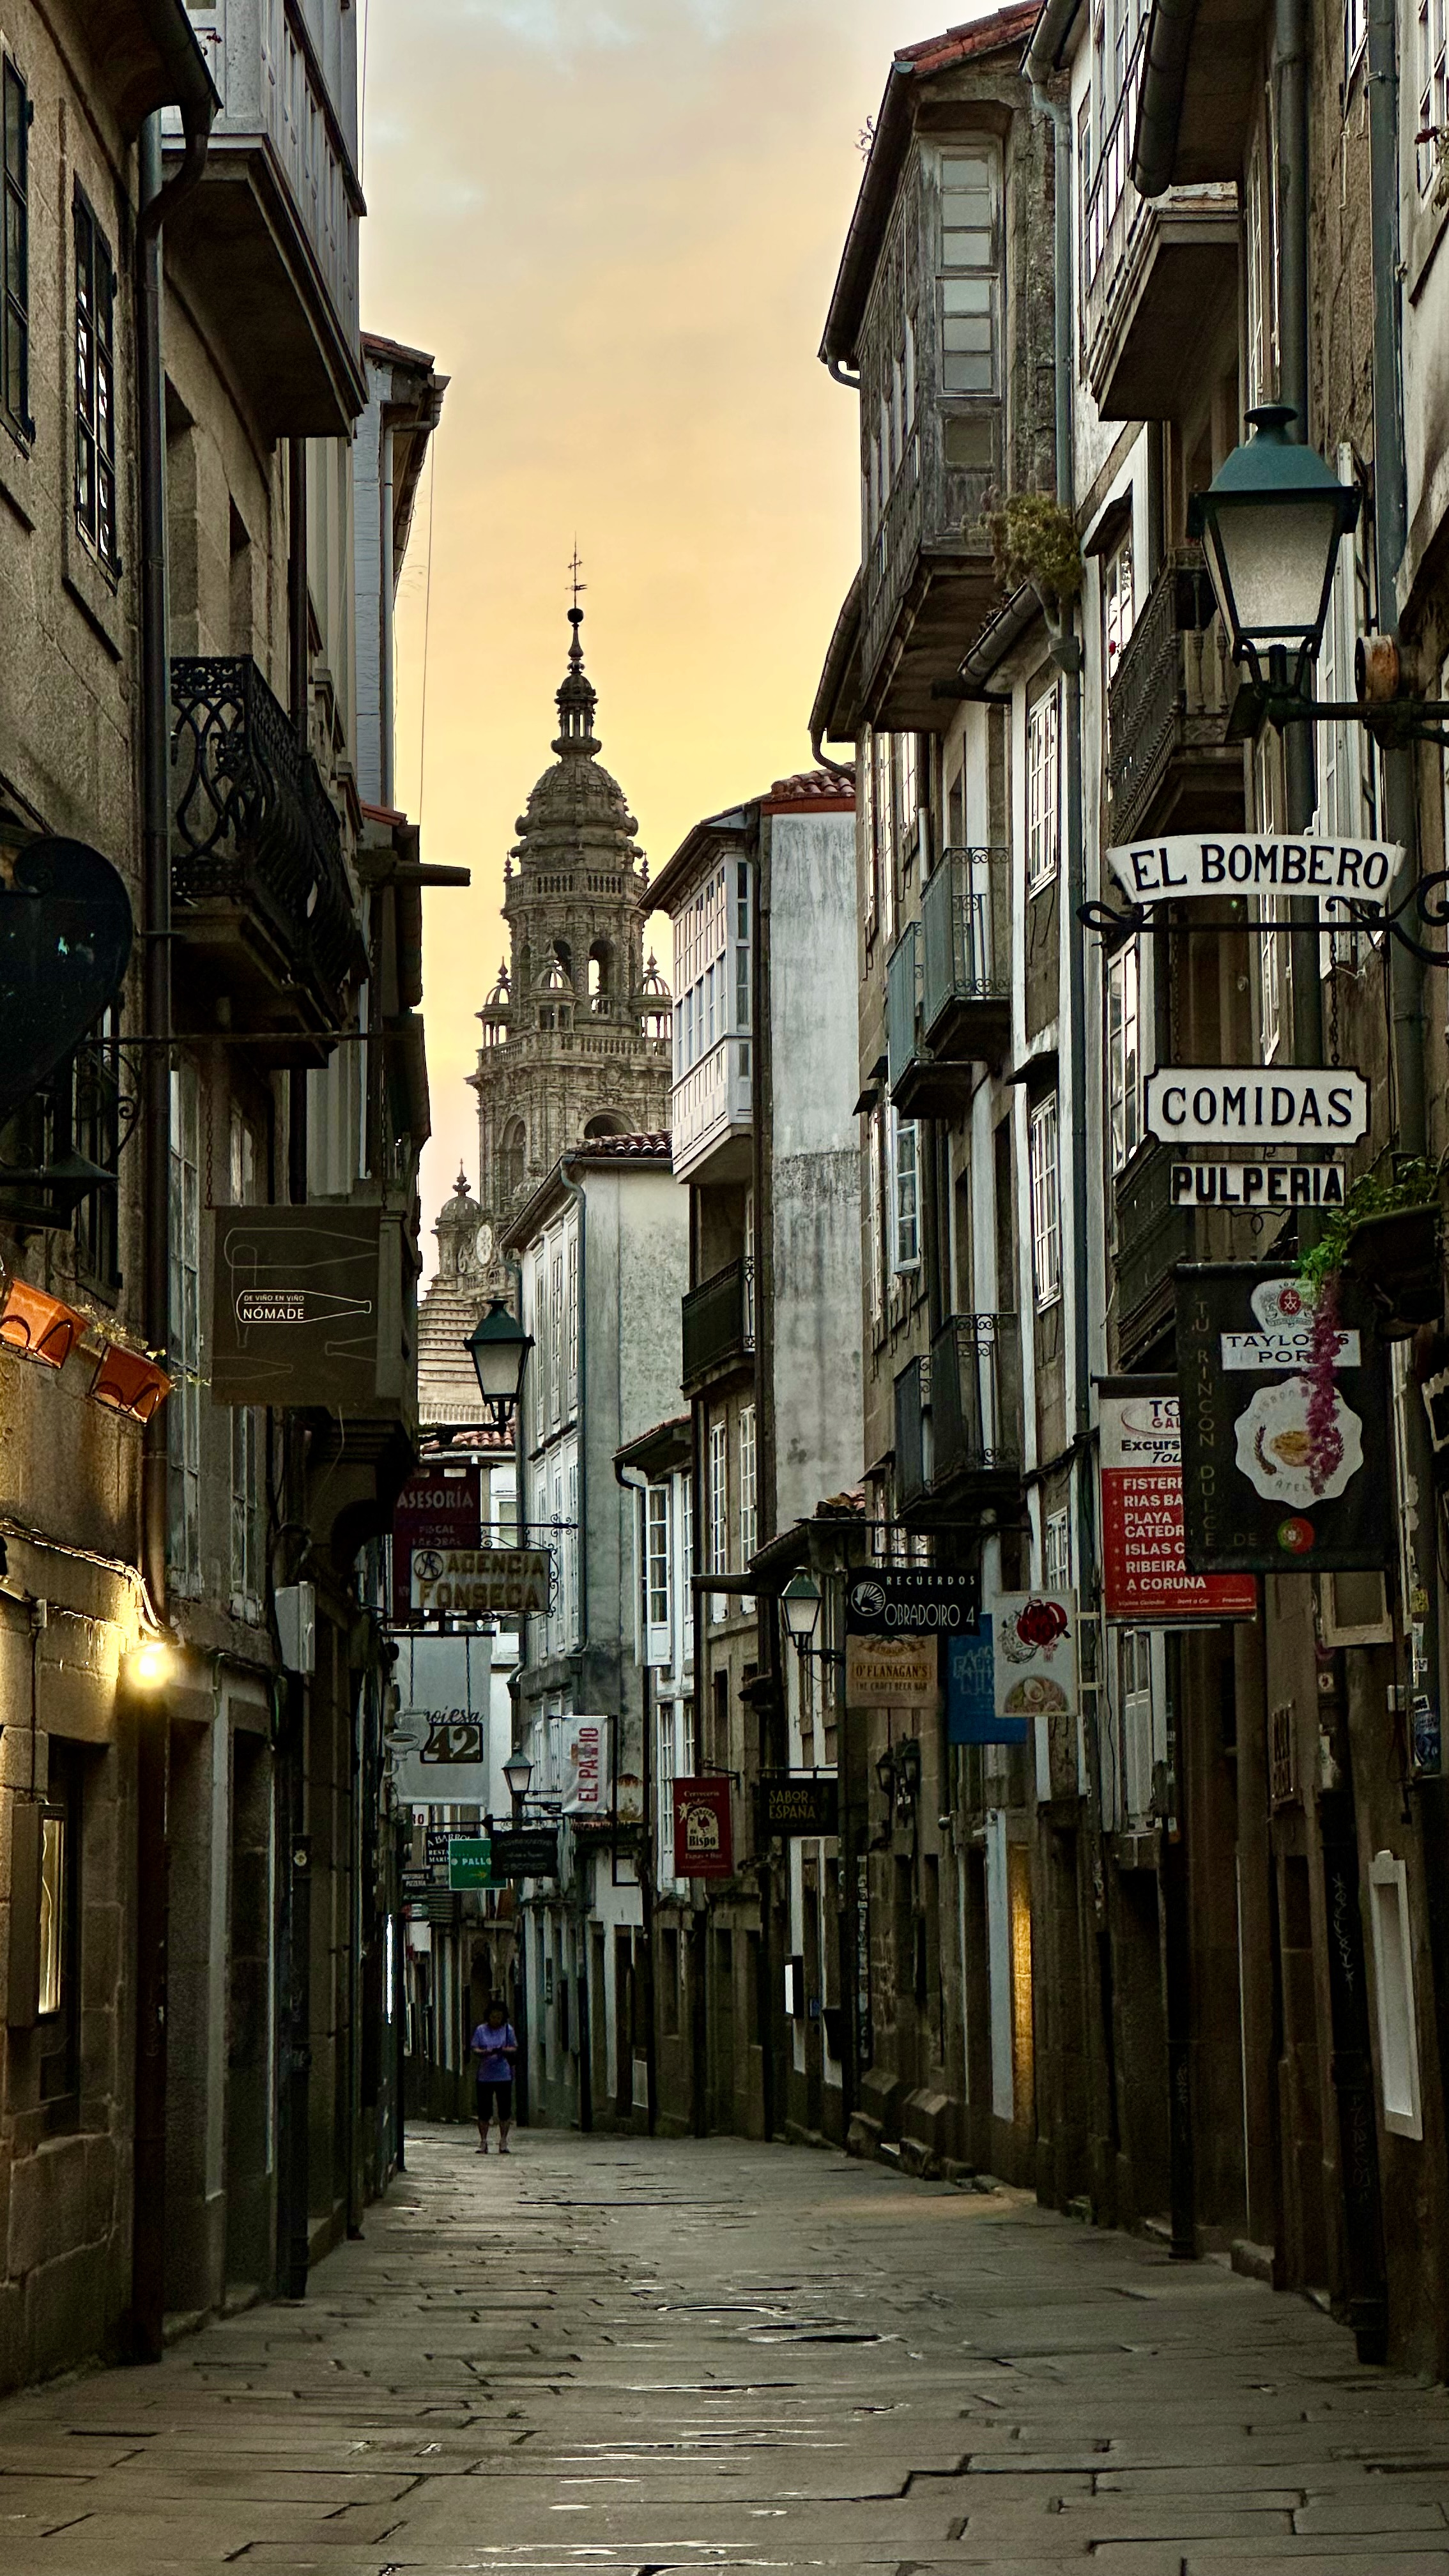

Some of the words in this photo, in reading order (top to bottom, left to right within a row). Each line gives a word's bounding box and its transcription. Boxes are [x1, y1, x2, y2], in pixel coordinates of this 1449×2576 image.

[1130, 850, 1187, 891] EL
[1200, 843, 1389, 889] BOMBERO
[1162, 1086, 1353, 1127] COMIDAS
[1172, 1166, 1343, 1203] PULPERIA
[243, 1305, 304, 1319] NÓMADE
[1121, 1440, 1180, 1452] Excurs
[397, 1486, 473, 1508] ASESORÍA
[1124, 1494, 1160, 1506] RIAS
[1124, 1512, 1172, 1524] PLAYA
[1125, 1543, 1171, 1556] ISLAS
[1126, 1560, 1186, 1573] RIBEIRA
[887, 1576, 975, 1586] RECUERDOS
[1126, 1579, 1137, 1591] A
[419, 1582, 540, 1609] FONSECA
[885, 1604, 960, 1627] OBRADOIRO
[966, 1606, 975, 1627] 4
[427, 1726, 480, 1761] 42
[578, 1783, 598, 1802] EL
[769, 1790, 808, 1804] SABOR
[689, 1836, 716, 1847] Bispo
